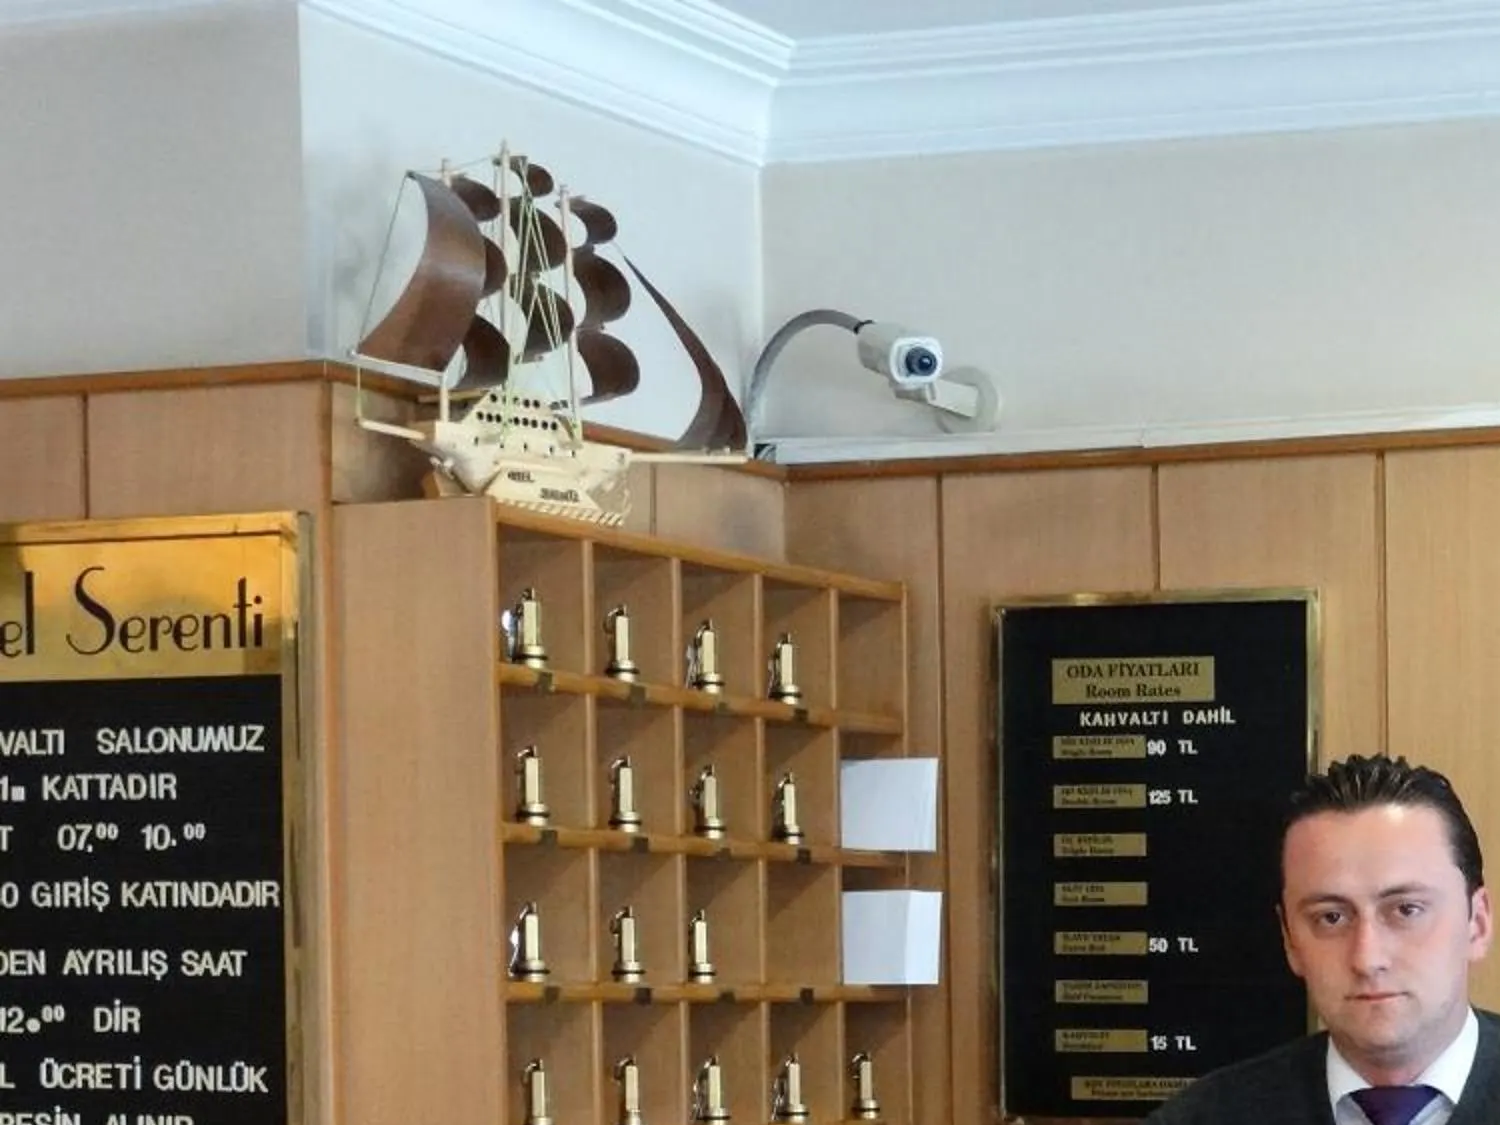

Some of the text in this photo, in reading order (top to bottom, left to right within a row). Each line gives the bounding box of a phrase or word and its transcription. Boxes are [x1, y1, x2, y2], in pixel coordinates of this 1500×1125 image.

[0, 566, 264, 657] el Serenti
[1067, 664, 1103, 679] ODA
[1085, 682, 1181, 698] Room Rates
[1079, 705, 1236, 727] KAHVALTI DAHİL
[96, 724, 265, 755] SALONUMUZ
[1177, 739, 1198, 755] TL
[42, 772, 177, 801] KATTADIR
[1177, 789, 1199, 804] TL
[121, 880, 280, 908] KATINDADIR
[1177, 937, 1199, 953] TL
[62, 949, 169, 981] AYRILIŞ
[180, 949, 248, 977] SAAT
[93, 998, 141, 1033] DİR
[1150, 1035, 1197, 1051] 15 TL
[39, 1055, 142, 1090] ÜCRETİ
[153, 1059, 269, 1093] GÜNLÜK
